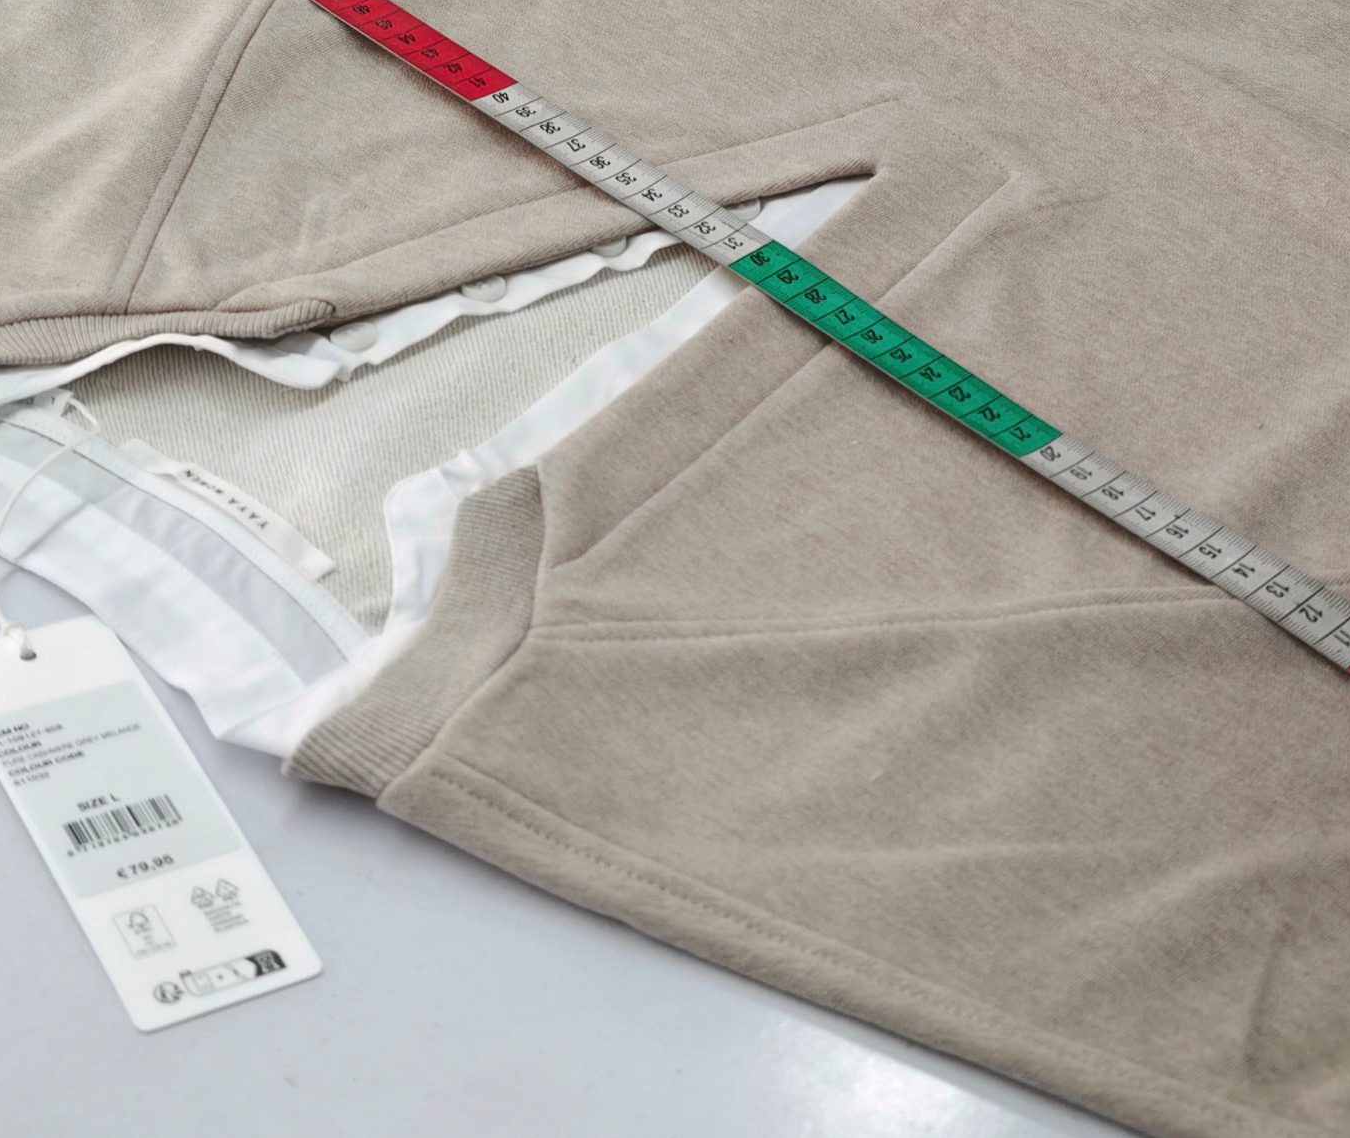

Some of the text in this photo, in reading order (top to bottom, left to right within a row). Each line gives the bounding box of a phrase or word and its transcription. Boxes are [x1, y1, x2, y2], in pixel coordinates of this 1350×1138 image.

[492, 92, 510, 104] 40
[516, 106, 536, 117] 39
[540, 122, 561, 134] 38
[567, 139, 586, 152] 37
[590, 156, 610, 169] 36
[615, 172, 636, 185] 35
[642, 189, 662, 202] 34
[668, 205, 689, 218] 33
[694, 221, 716, 234] 32
[723, 237, 744, 250] 31
[750, 250, 770, 266] 30
[777, 270, 799, 284] 29
[805, 288, 827, 305] 28
[834, 309, 855, 324] 27
[861, 329, 883, 343] 26
[890, 349, 912, 362] 25
[919, 367, 941, 382] 24
[949, 386, 971, 402] 23
[978, 407, 1000, 422] 22
[1009, 427, 1031, 442] 21
[1040, 446, 1061, 461] 20
[1070, 466, 1092, 480] 19
[1102, 486, 1123, 501] 18
[1135, 506, 1156, 521] 17
[1166, 524, 1189, 540] 16
[1199, 543, 1222, 560] 15
[1232, 563, 1255, 578] 14
[1266, 581, 1289, 599] 13
[1299, 604, 1323, 624] 12
[228, 497, 269, 529] YAYA
[8, 751, 85, 777] COLOUR CODE
[77, 793, 120, 811] SIZE L
